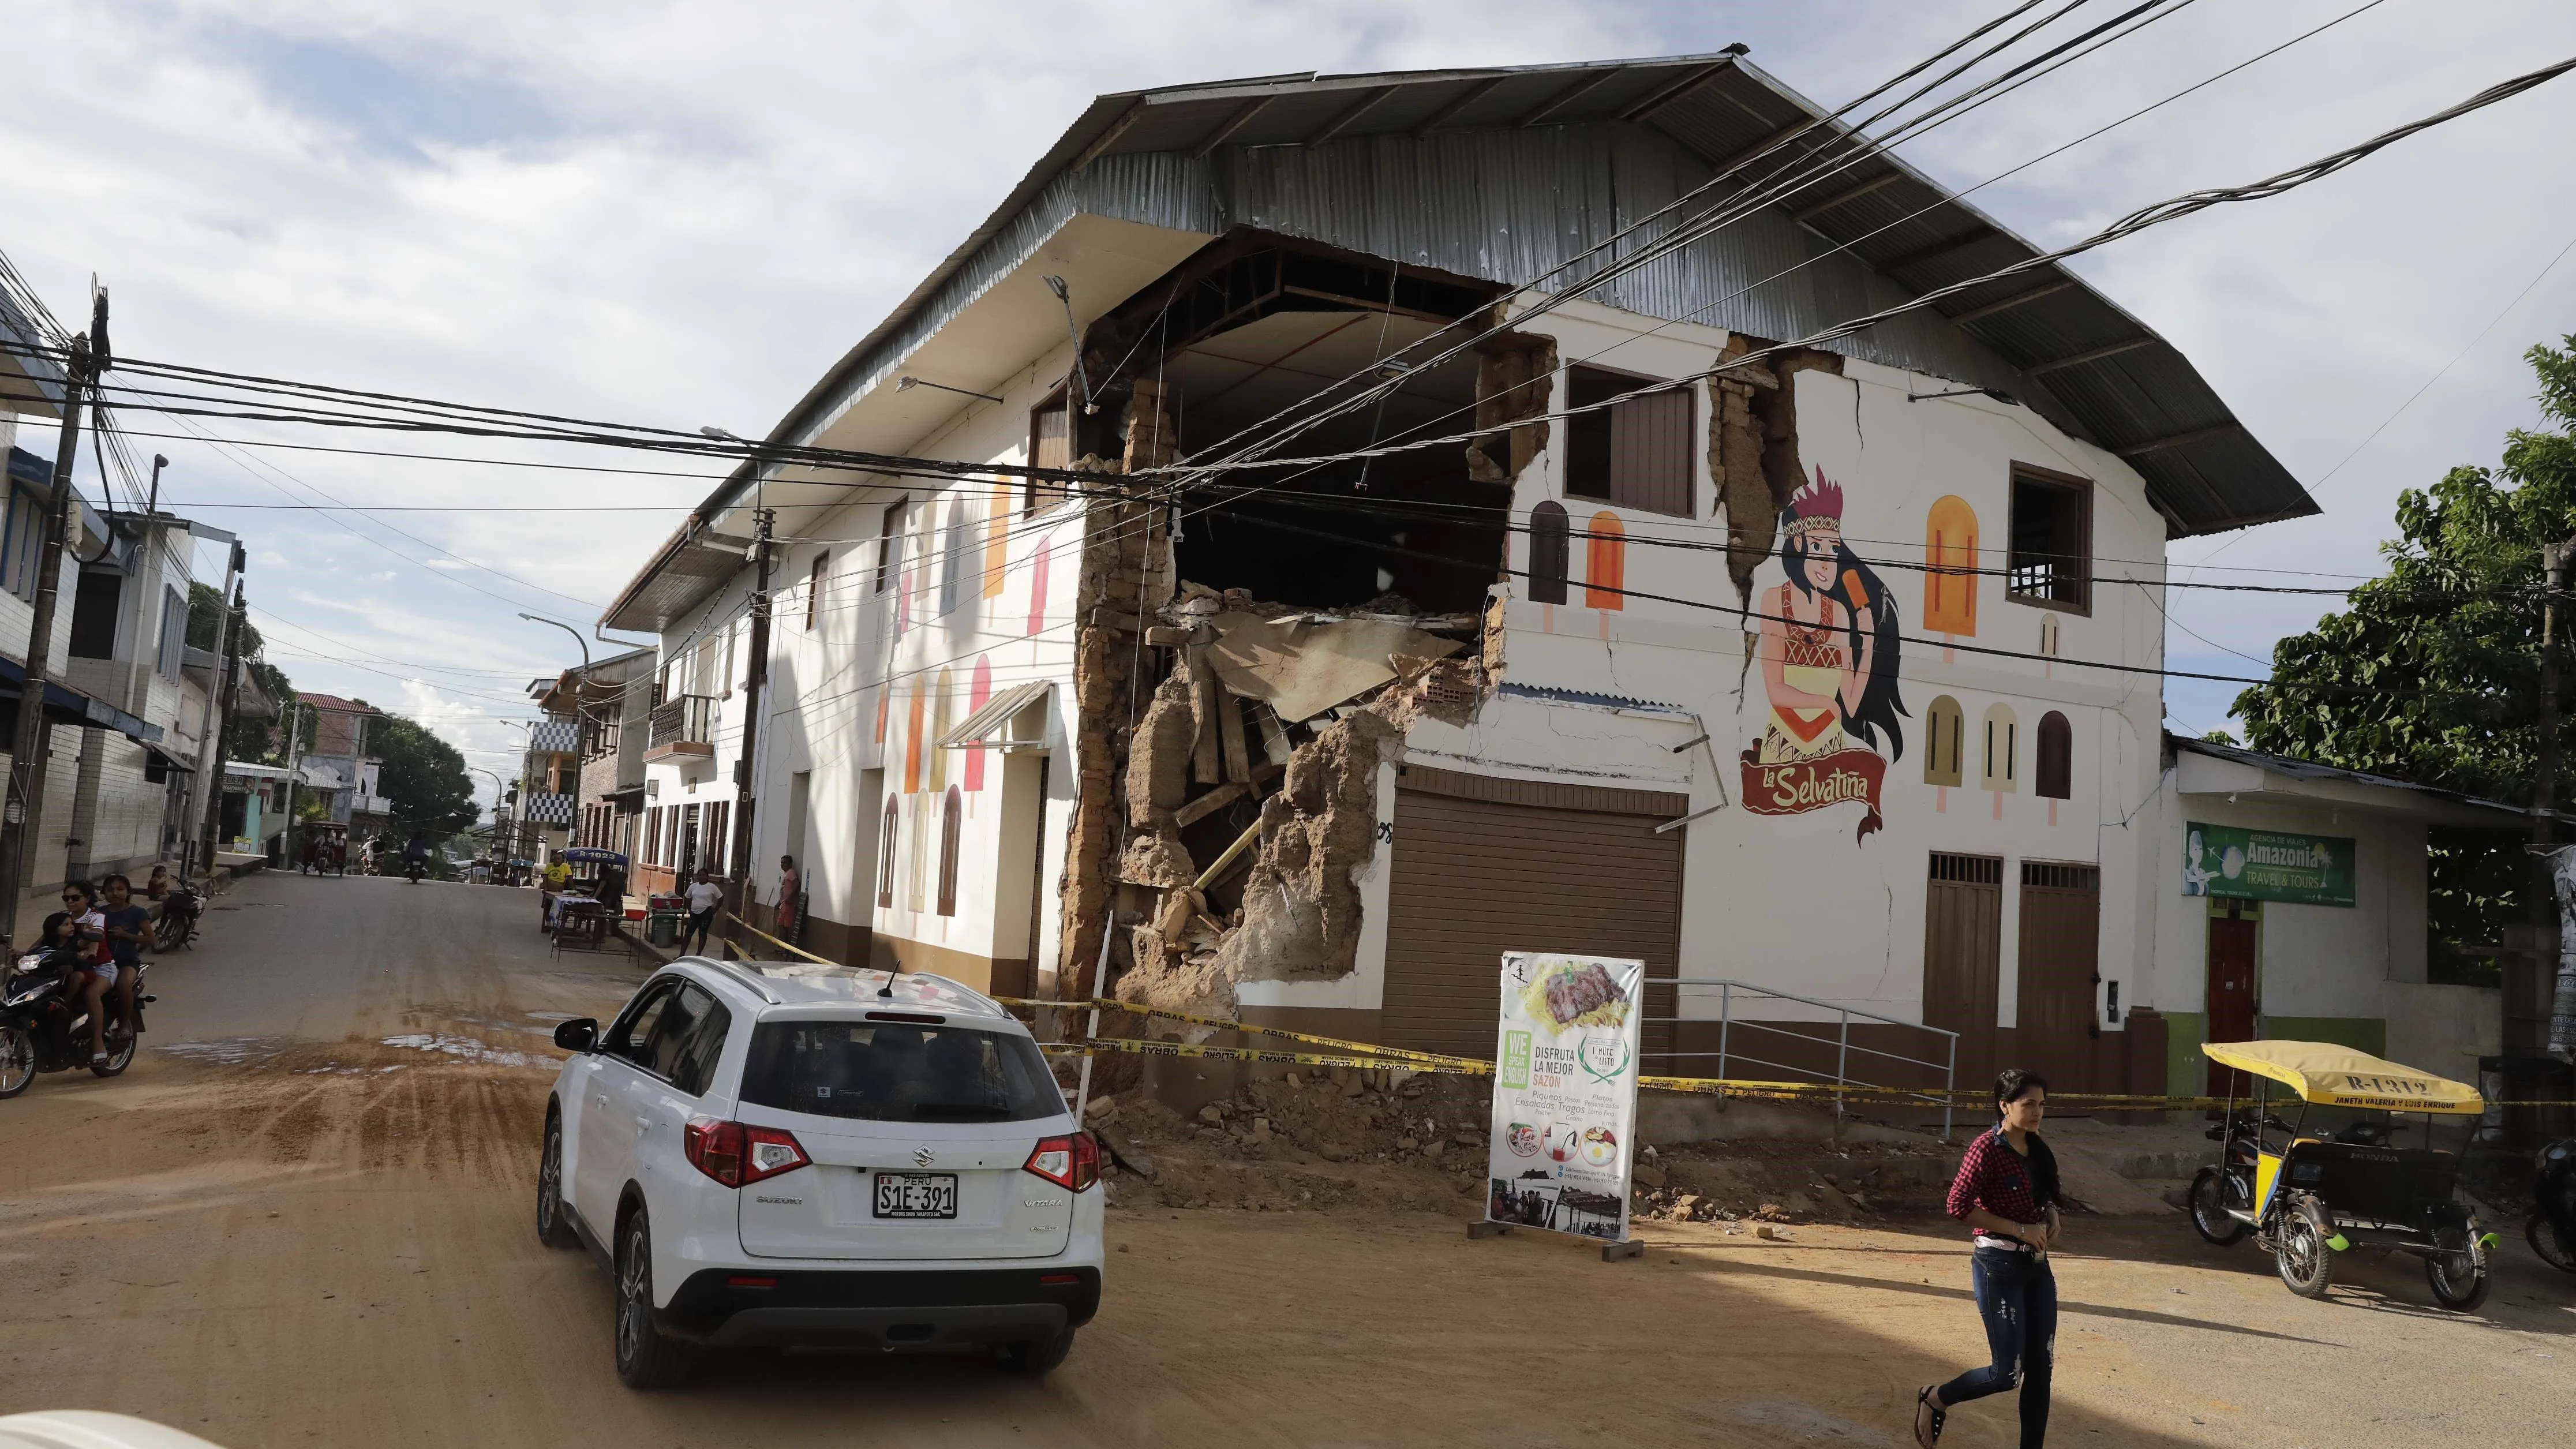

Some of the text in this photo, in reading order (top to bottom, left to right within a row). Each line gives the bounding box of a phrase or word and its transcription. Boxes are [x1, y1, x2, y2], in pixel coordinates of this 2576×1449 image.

[1762, 766, 1867, 807] La Selvatiña
[2250, 834, 2275, 843] AGENCIA
[2286, 838, 2306, 846] VIAJES
[579, 851, 615, 859] R-1023
[2246, 841, 2318, 868] Amazonia
[2246, 871, 2319, 889] TRAVEL & TOURS
[1509, 1033, 1528, 1055] WE
[1140, 1046, 1178, 1056] OBRAS
[1203, 1051, 1240, 1061] PELIGRO
[1535, 1046, 1575, 1062] DISFRUTA
[1259, 1055, 1296, 1064] OBRAS
[1509, 1056, 1525, 1066] SPEAK
[1599, 1057, 1614, 1066] LISTO
[1534, 1060, 1574, 1076] LA MEJOR
[1504, 1066, 1526, 1085] ENGLISH
[2345, 1076, 2429, 1096] R-1312
[1532, 1090, 1562, 1102] Piqueos
[1592, 1094, 1613, 1102] Platos
[1515, 1097, 1555, 1110] Ensaladas
[1558, 1101, 1585, 1115] Tragos
[2334, 1096, 2363, 1105] JANETH
[2365, 1098, 2395, 1106] VALERIA
[2424, 1100, 2455, 1109] ENRIQUE
[2350, 1153, 2399, 1162] HONDA
[904, 1177, 931, 1185] PERU
[756, 1196, 803, 1204] SUZUKI
[880, 1186, 952, 1211] S1E-391
